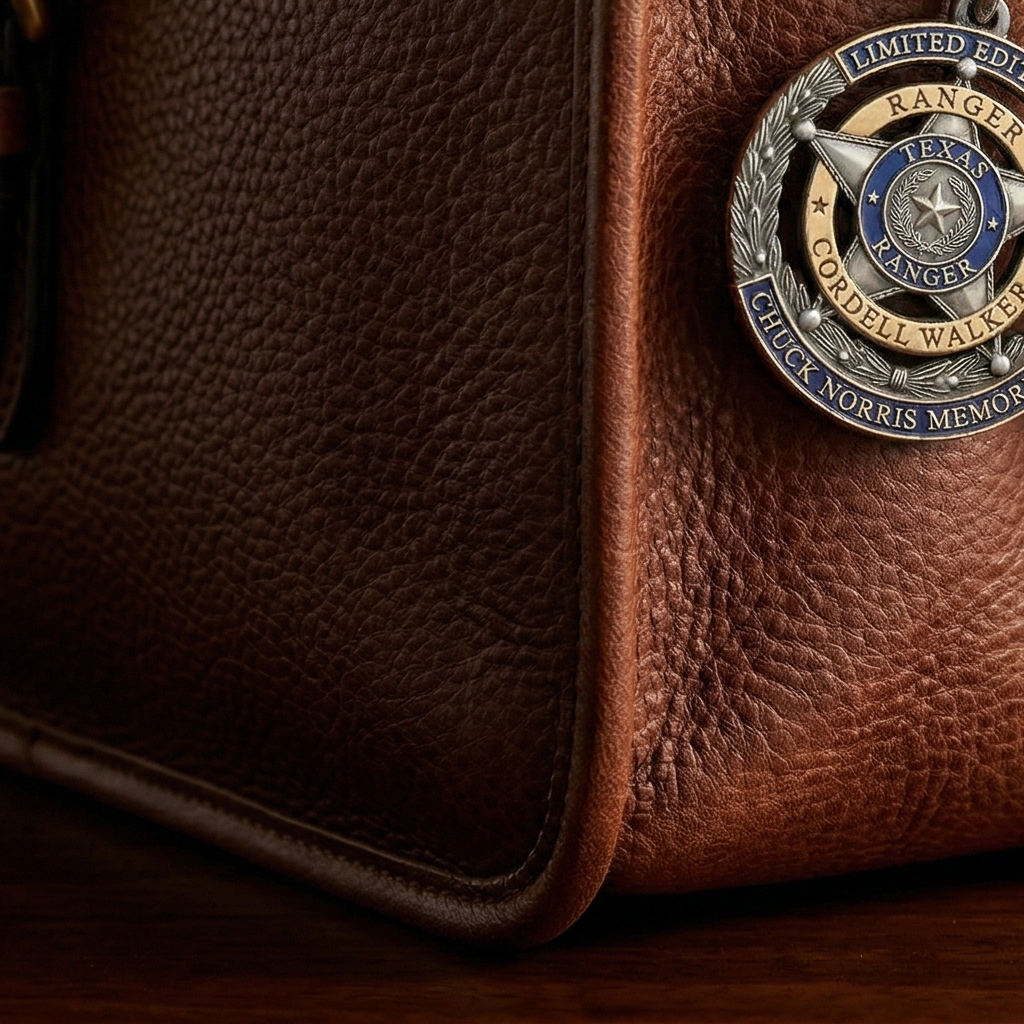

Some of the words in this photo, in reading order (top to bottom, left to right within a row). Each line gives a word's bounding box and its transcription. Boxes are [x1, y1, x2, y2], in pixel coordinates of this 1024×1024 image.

[850, 32, 966, 71] LIMITED
[886, 88, 1024, 146] RANGER
[900, 142, 990, 179] TEXAS
[872, 235, 979, 286] RANGER
[811, 237, 911, 347] CORDELL
[750, 291, 820, 384] CHUCK
[817, 374, 918, 430] NORRIS
